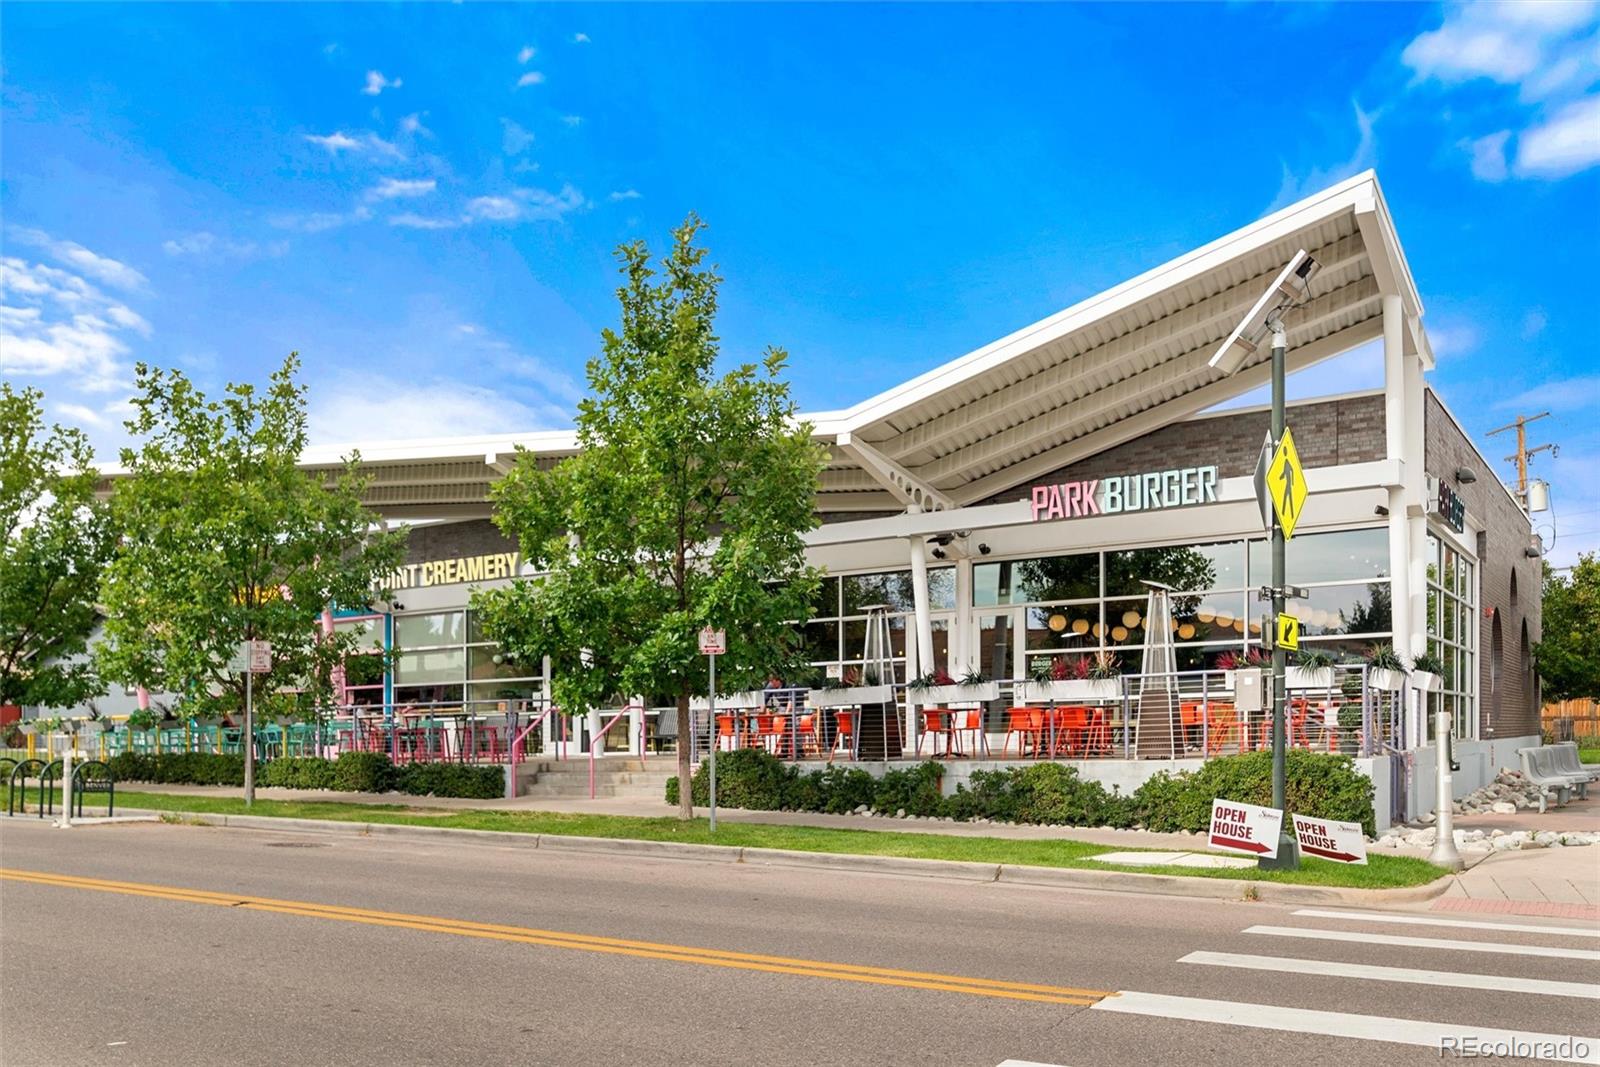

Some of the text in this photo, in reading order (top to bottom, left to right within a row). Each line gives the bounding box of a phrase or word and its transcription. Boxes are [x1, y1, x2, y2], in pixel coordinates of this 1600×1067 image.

[1031, 465, 1218, 521] PARK BURGER
[421, 551, 519, 587] CREAMERY
[1215, 806, 1247, 824] OPEN
[1213, 821, 1253, 840] HOUSE
[1296, 821, 1328, 837] OPEN
[1299, 832, 1338, 850] HOUSE
